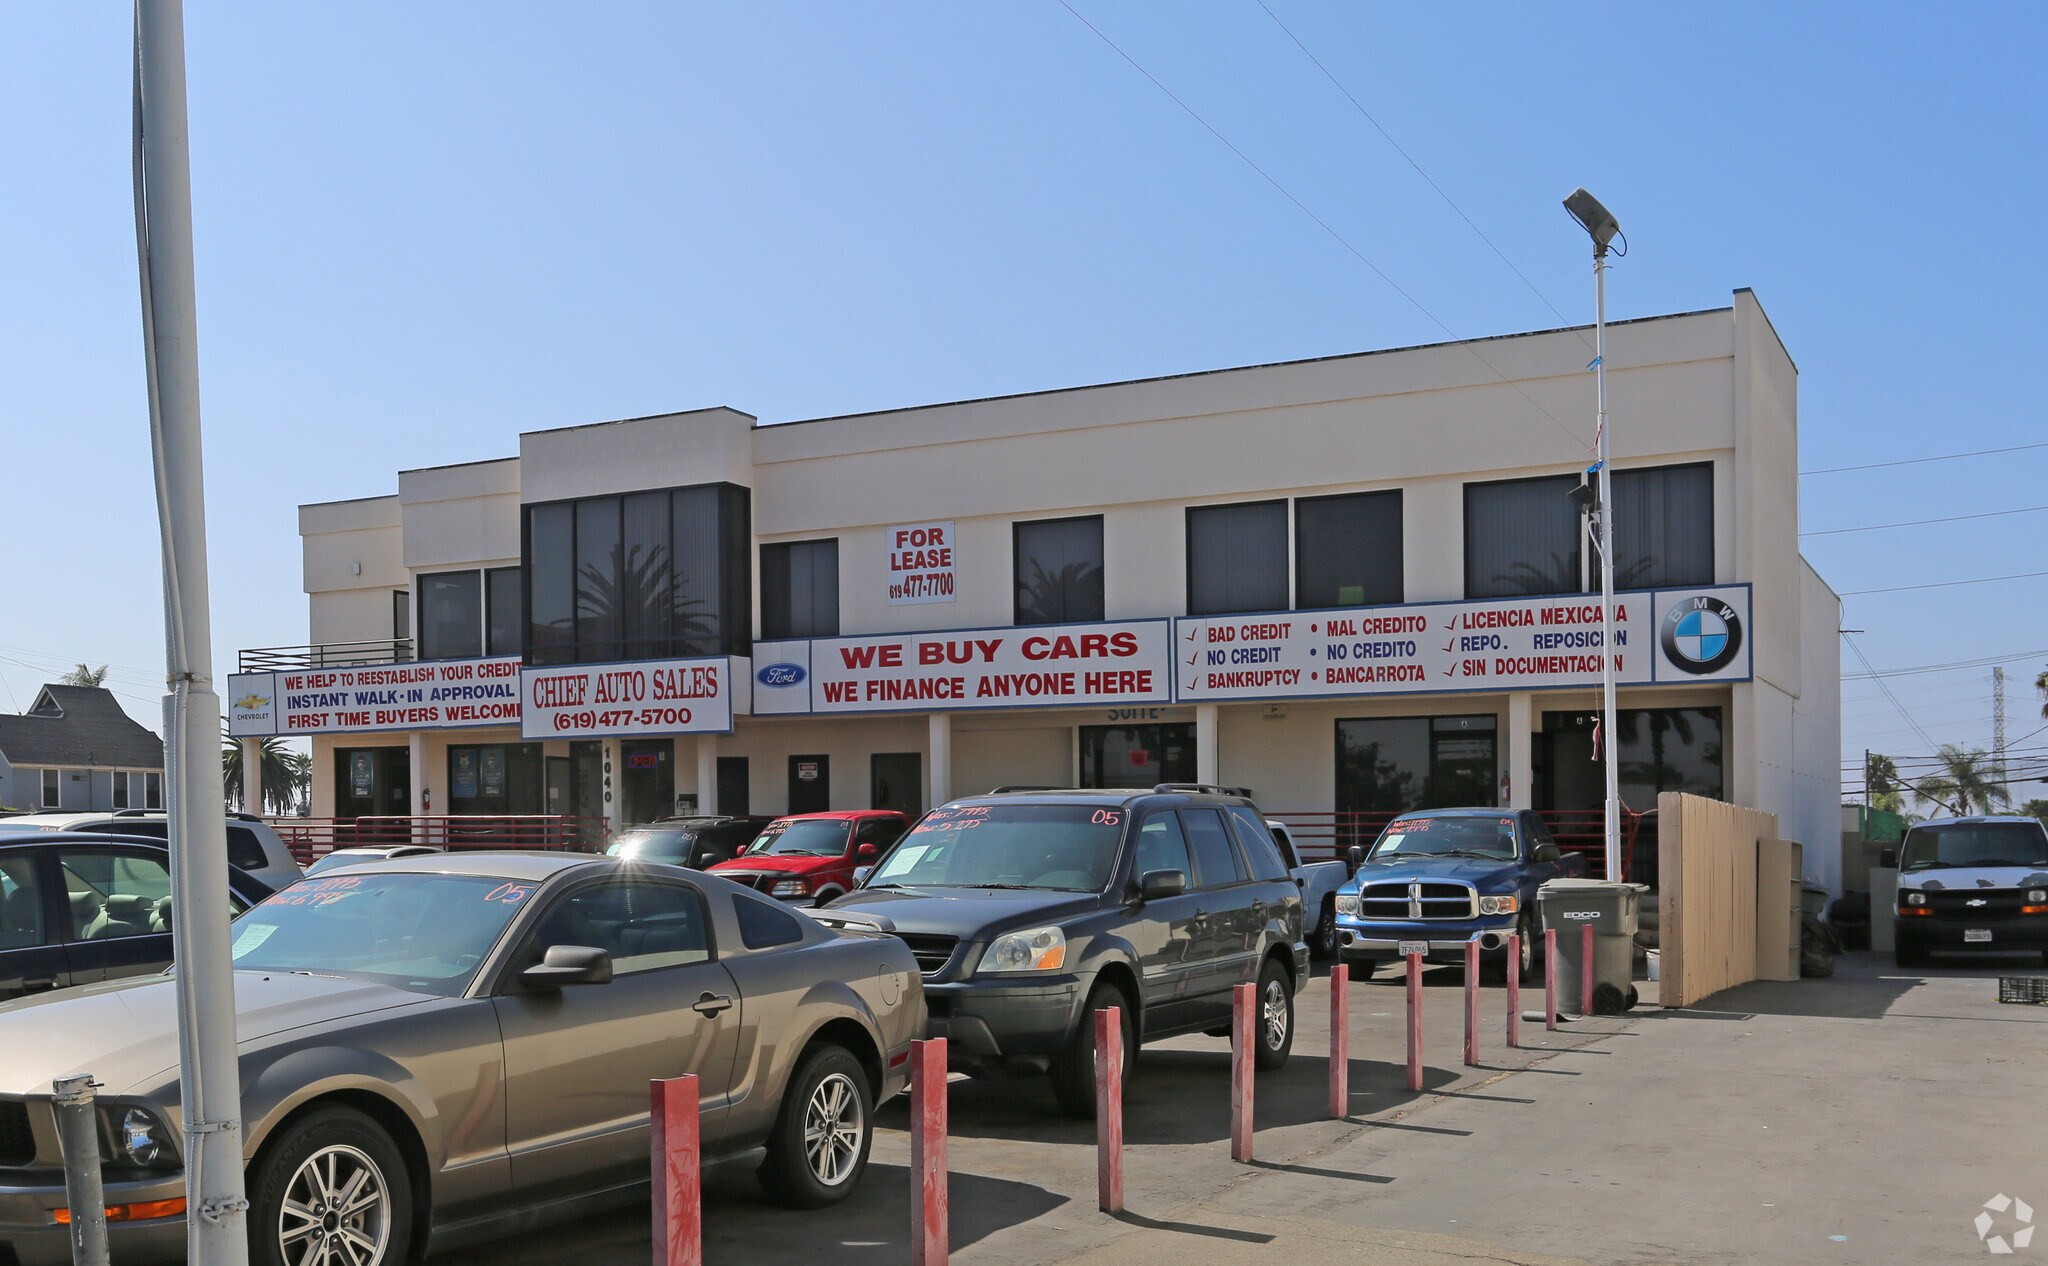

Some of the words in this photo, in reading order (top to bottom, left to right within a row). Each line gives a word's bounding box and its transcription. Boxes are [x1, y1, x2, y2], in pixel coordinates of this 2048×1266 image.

[896, 527, 944, 549] FOR
[890, 547, 952, 571] LEASE
[889, 582, 902, 600] 619
[903, 572, 954, 598] 477-7700
[1207, 626, 1236, 643] BAD
[1240, 622, 1292, 641] CREDIT
[1326, 619, 1358, 637] MAL
[1362, 615, 1428, 635] CREDITO
[1462, 609, 1535, 630] LICENCIA
[1540, 604, 1628, 626] MEXICAA
[840, 644, 903, 670] WE
[918, 638, 1004, 665] BUY
[1020, 631, 1139, 661] CARS
[1533, 629, 1628, 650] REPOSICIN
[1207, 649, 1226, 666] NO
[1230, 646, 1282, 665] CREDIT
[1327, 643, 1348, 661] NO
[1352, 640, 1417, 659] CREDITO
[1462, 659, 1486, 677] SIN
[1495, 654, 1623, 676] DOCUMENTACIN
[285, 675, 303, 691] WE
[306, 673, 337, 689] HELP
[340, 672, 354, 687] TO
[357, 663, 435, 686] REESTABLISH
[439, 663, 473, 681] YOUR
[477, 660, 522, 678] CREDIT
[532, 674, 590, 709] CHIEF
[594, 669, 646, 704] AUTO
[652, 666, 718, 700] SALES
[766, 666, 798, 685] Ford
[823, 681, 857, 703] WE
[866, 677, 965, 702] FINANCE
[976, 672, 1076, 698] ANYONE
[1084, 669, 1153, 695] HERE
[1207, 668, 1301, 689] BANKRUPTCY
[1325, 664, 1426, 685] BANCARROTA
[287, 691, 350, 710] INSTANT
[355, 688, 423, 706] WALK-IN
[430, 683, 515, 701] APPROVAL
[237, 712, 270, 721] CHEVROLET
[287, 711, 330, 729] FIRST
[335, 709, 371, 727] TIME
[376, 706, 439, 725] BUYERS
[629, 755, 656, 768] OPEN
[604, 747, 612, 803] 1040
[1091, 809, 1121, 826] 05
[484, 881, 536, 904] 05
